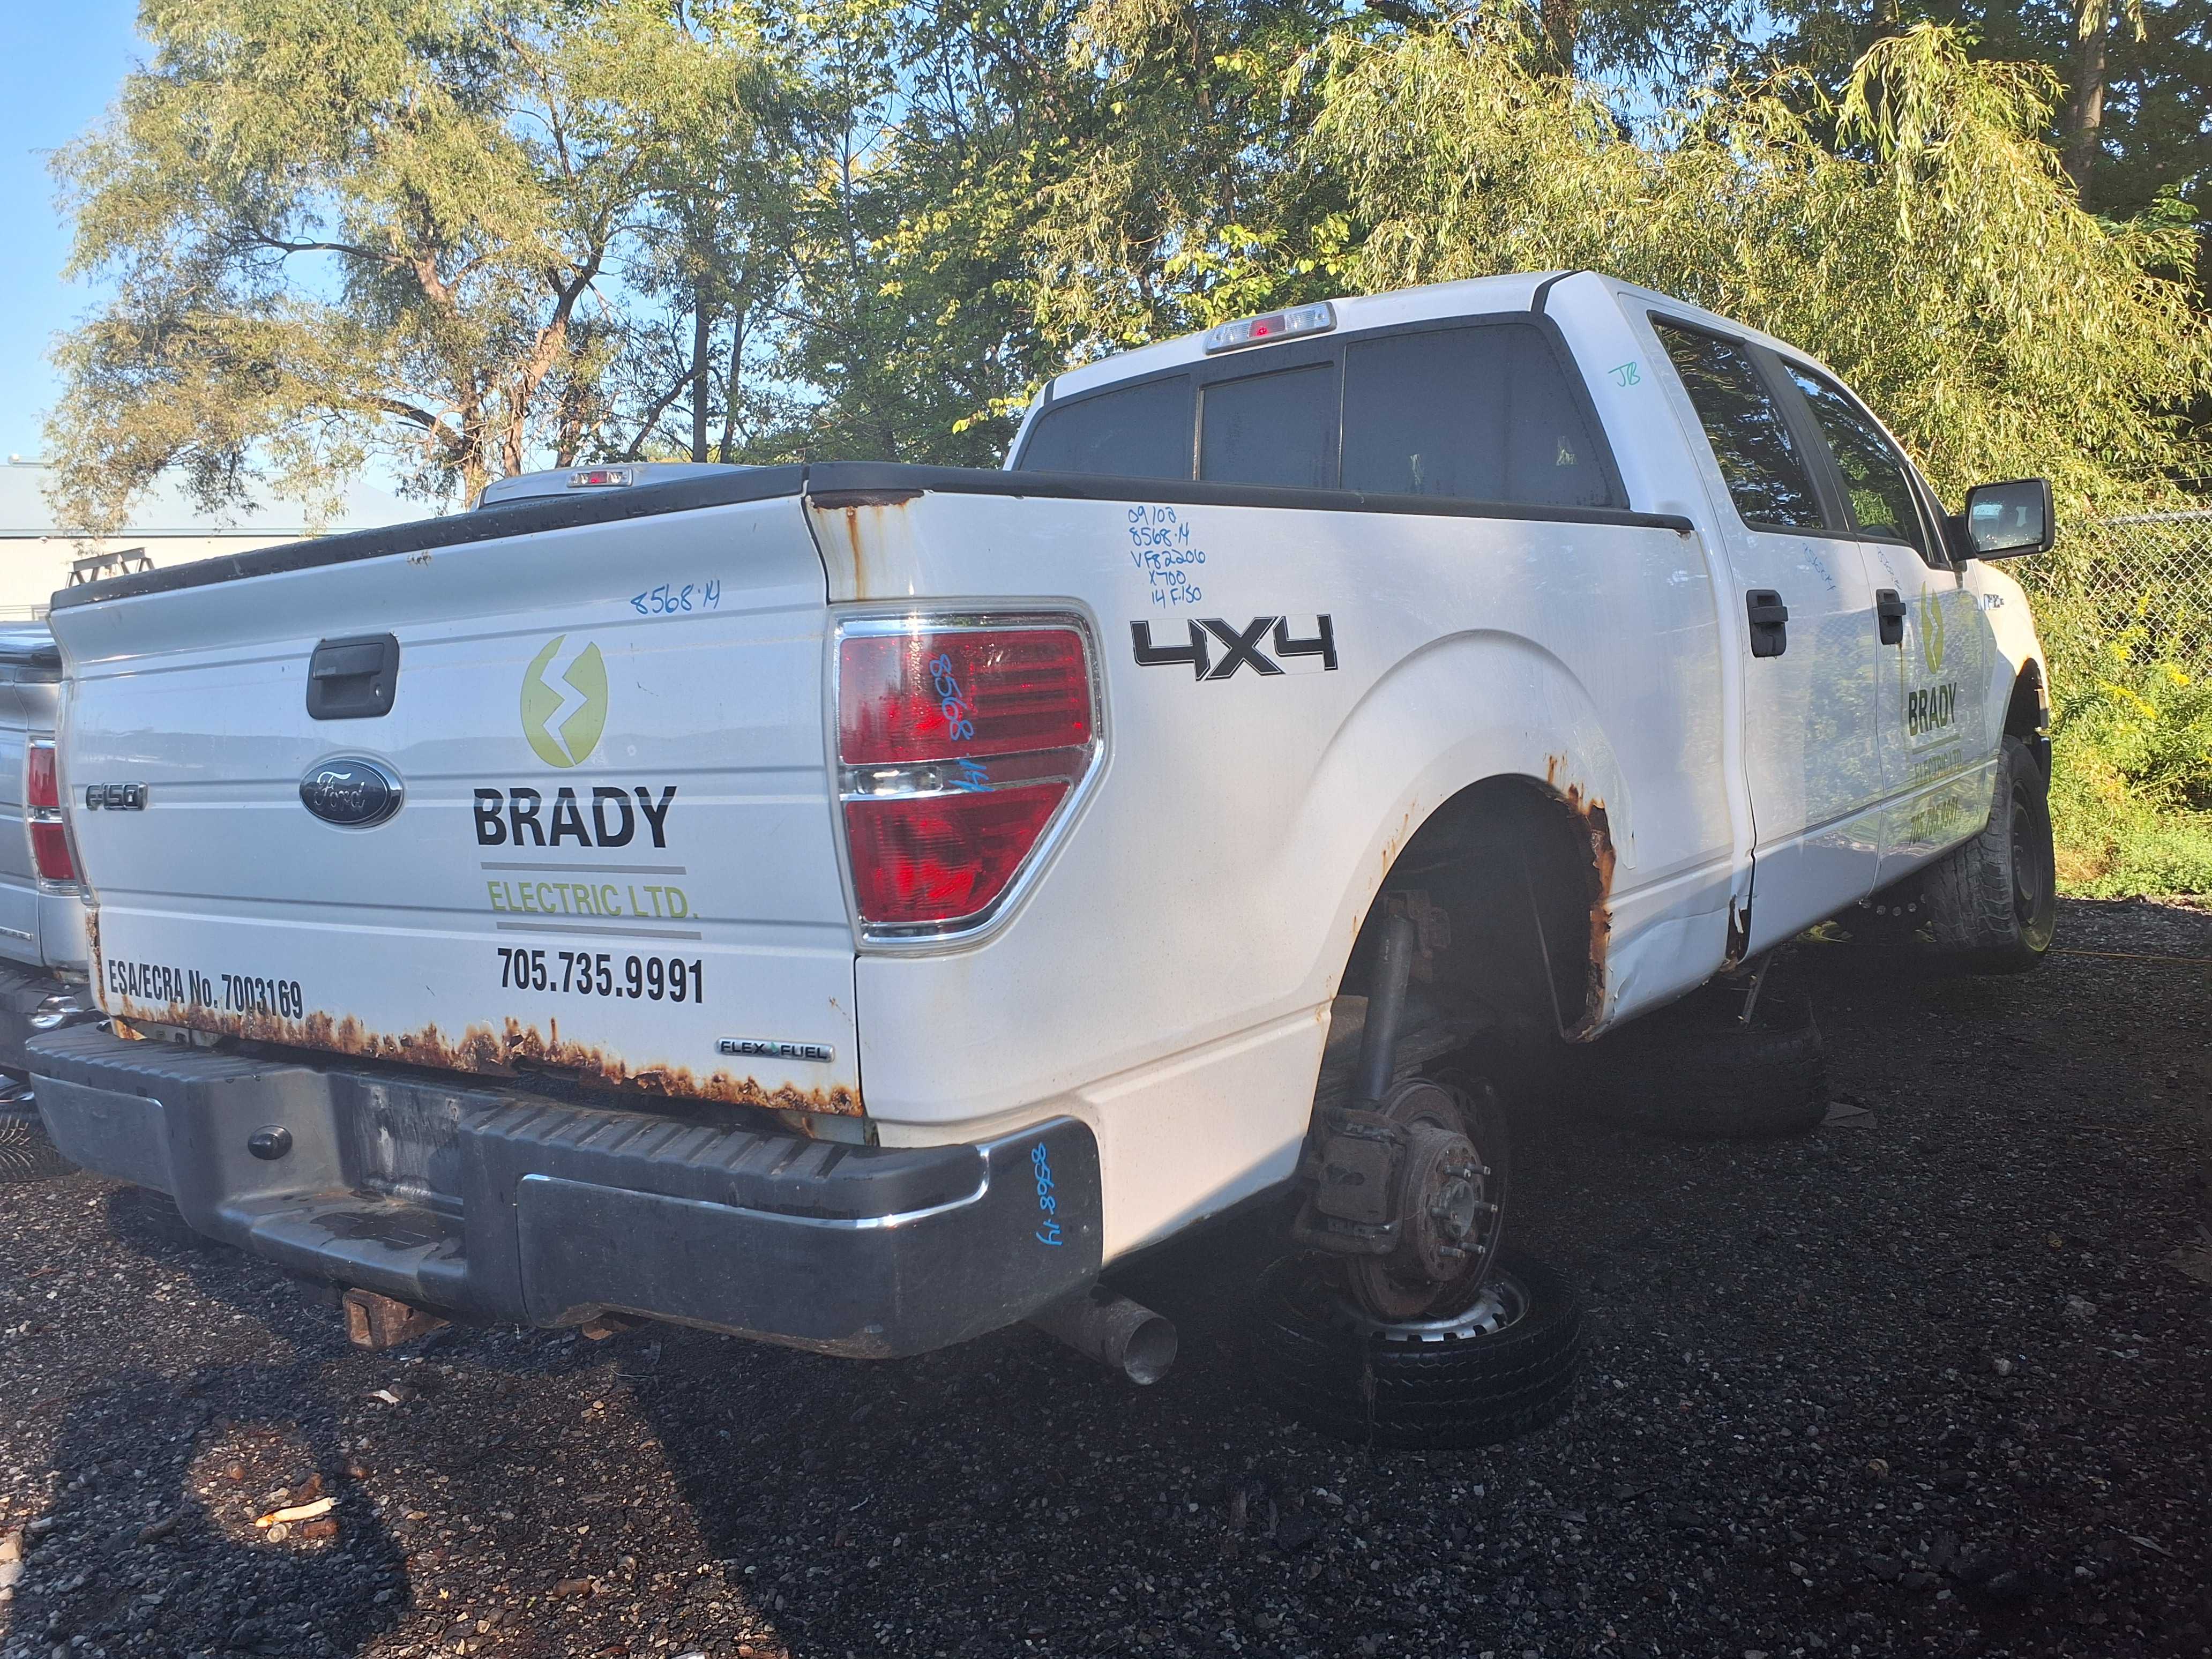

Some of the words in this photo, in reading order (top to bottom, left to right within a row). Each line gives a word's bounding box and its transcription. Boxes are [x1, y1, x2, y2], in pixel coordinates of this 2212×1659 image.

[1608, 362, 1641, 387] JB
[1909, 682, 1957, 736] BRADY
[313, 771, 366, 811] Ford
[473, 786, 677, 848] BRADY
[487, 881, 622, 916] ELECTRIC
[627, 885, 699, 919] LTD.
[108, 959, 185, 1004] ESA/ECRA
[189, 969, 218, 1008] No.
[221, 973, 303, 1019] 7003169
[497, 947, 703, 1004] 705.735.9991
[720, 1041, 765, 1055] FLEX
[780, 1045, 828, 1059] FUEL
